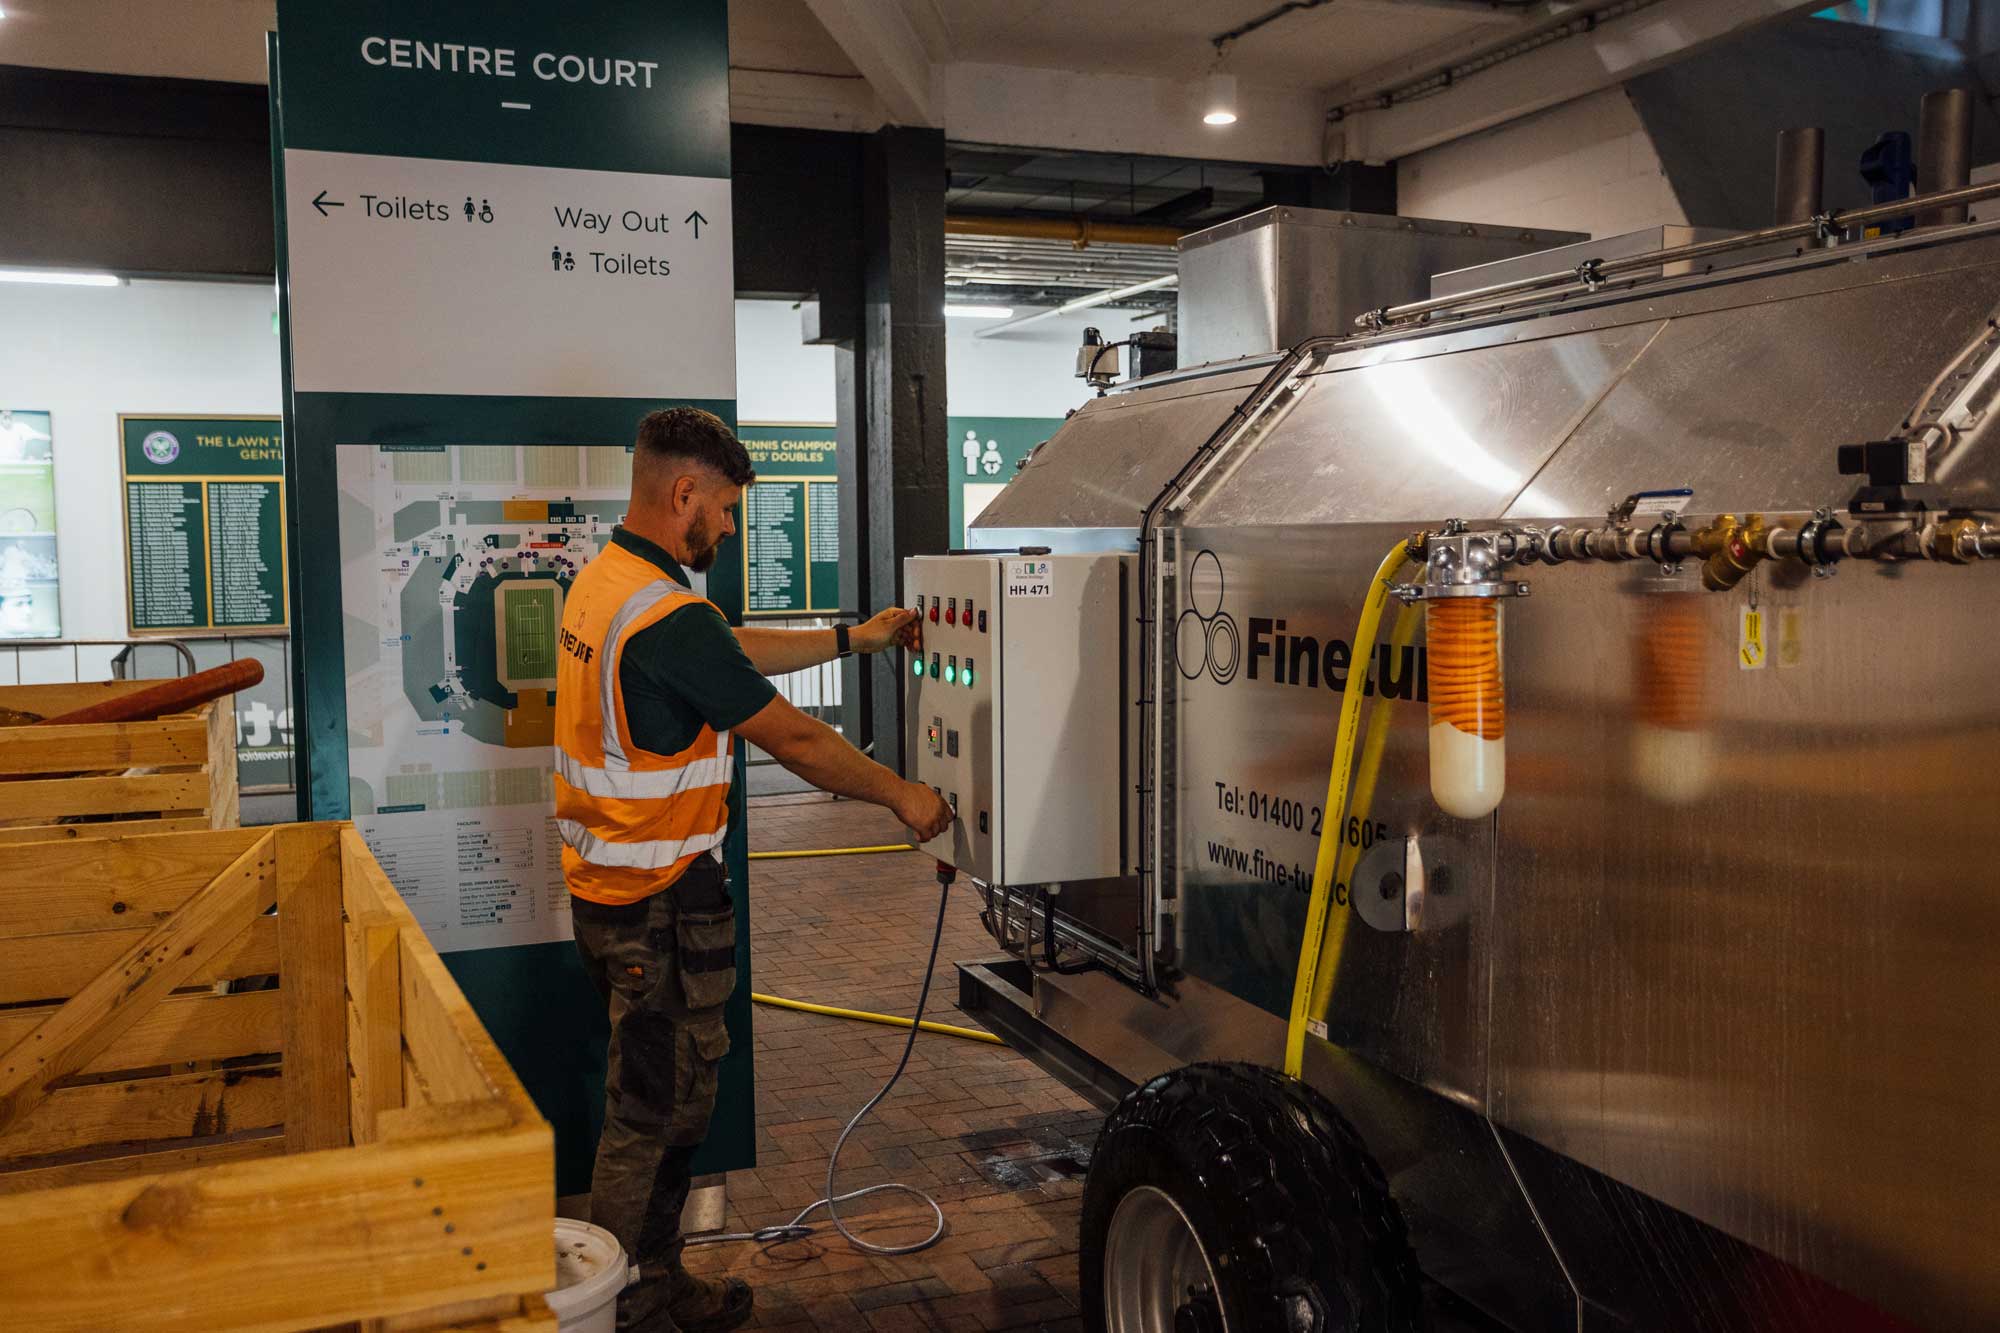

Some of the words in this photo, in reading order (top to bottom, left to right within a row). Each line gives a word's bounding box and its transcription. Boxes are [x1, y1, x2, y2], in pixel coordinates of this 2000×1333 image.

[361, 36, 516, 78] CENTRE
[533, 52, 659, 89] COURT
[359, 194, 450, 222] Toilets
[554, 205, 612, 234] Way
[622, 210, 670, 233] Out
[589, 252, 671, 277] Toilets
[197, 436, 223, 448] THE
[227, 436, 269, 448] LAWN
[740, 440, 779, 451] ENNIS
[771, 451, 824, 462] DOUBLES
[1009, 584, 1027, 596] HH
[1029, 584, 1049, 596] 471
[1215, 781, 1244, 816] Tel:
[1248, 790, 1304, 833] 01400
